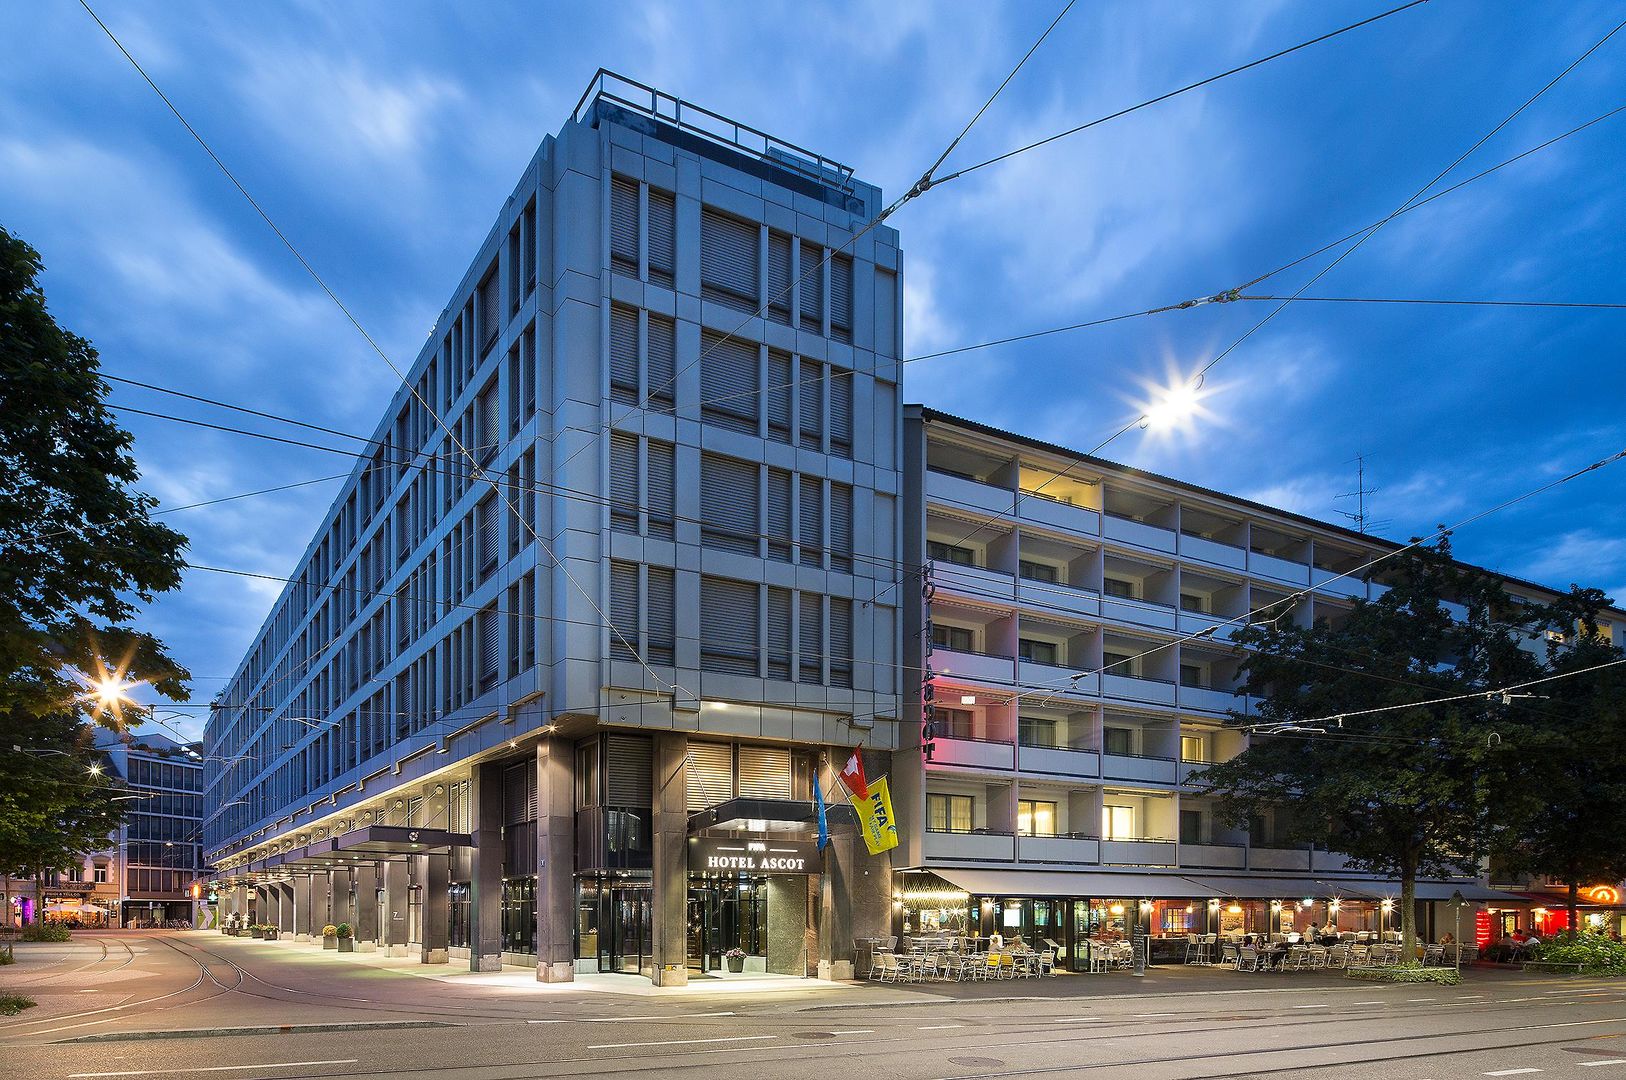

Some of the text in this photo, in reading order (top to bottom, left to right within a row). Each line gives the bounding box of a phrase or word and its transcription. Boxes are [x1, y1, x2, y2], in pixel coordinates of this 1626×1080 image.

[870, 792, 889, 827] FIFA
[707, 856, 805, 870] HOTEL ASCOT
